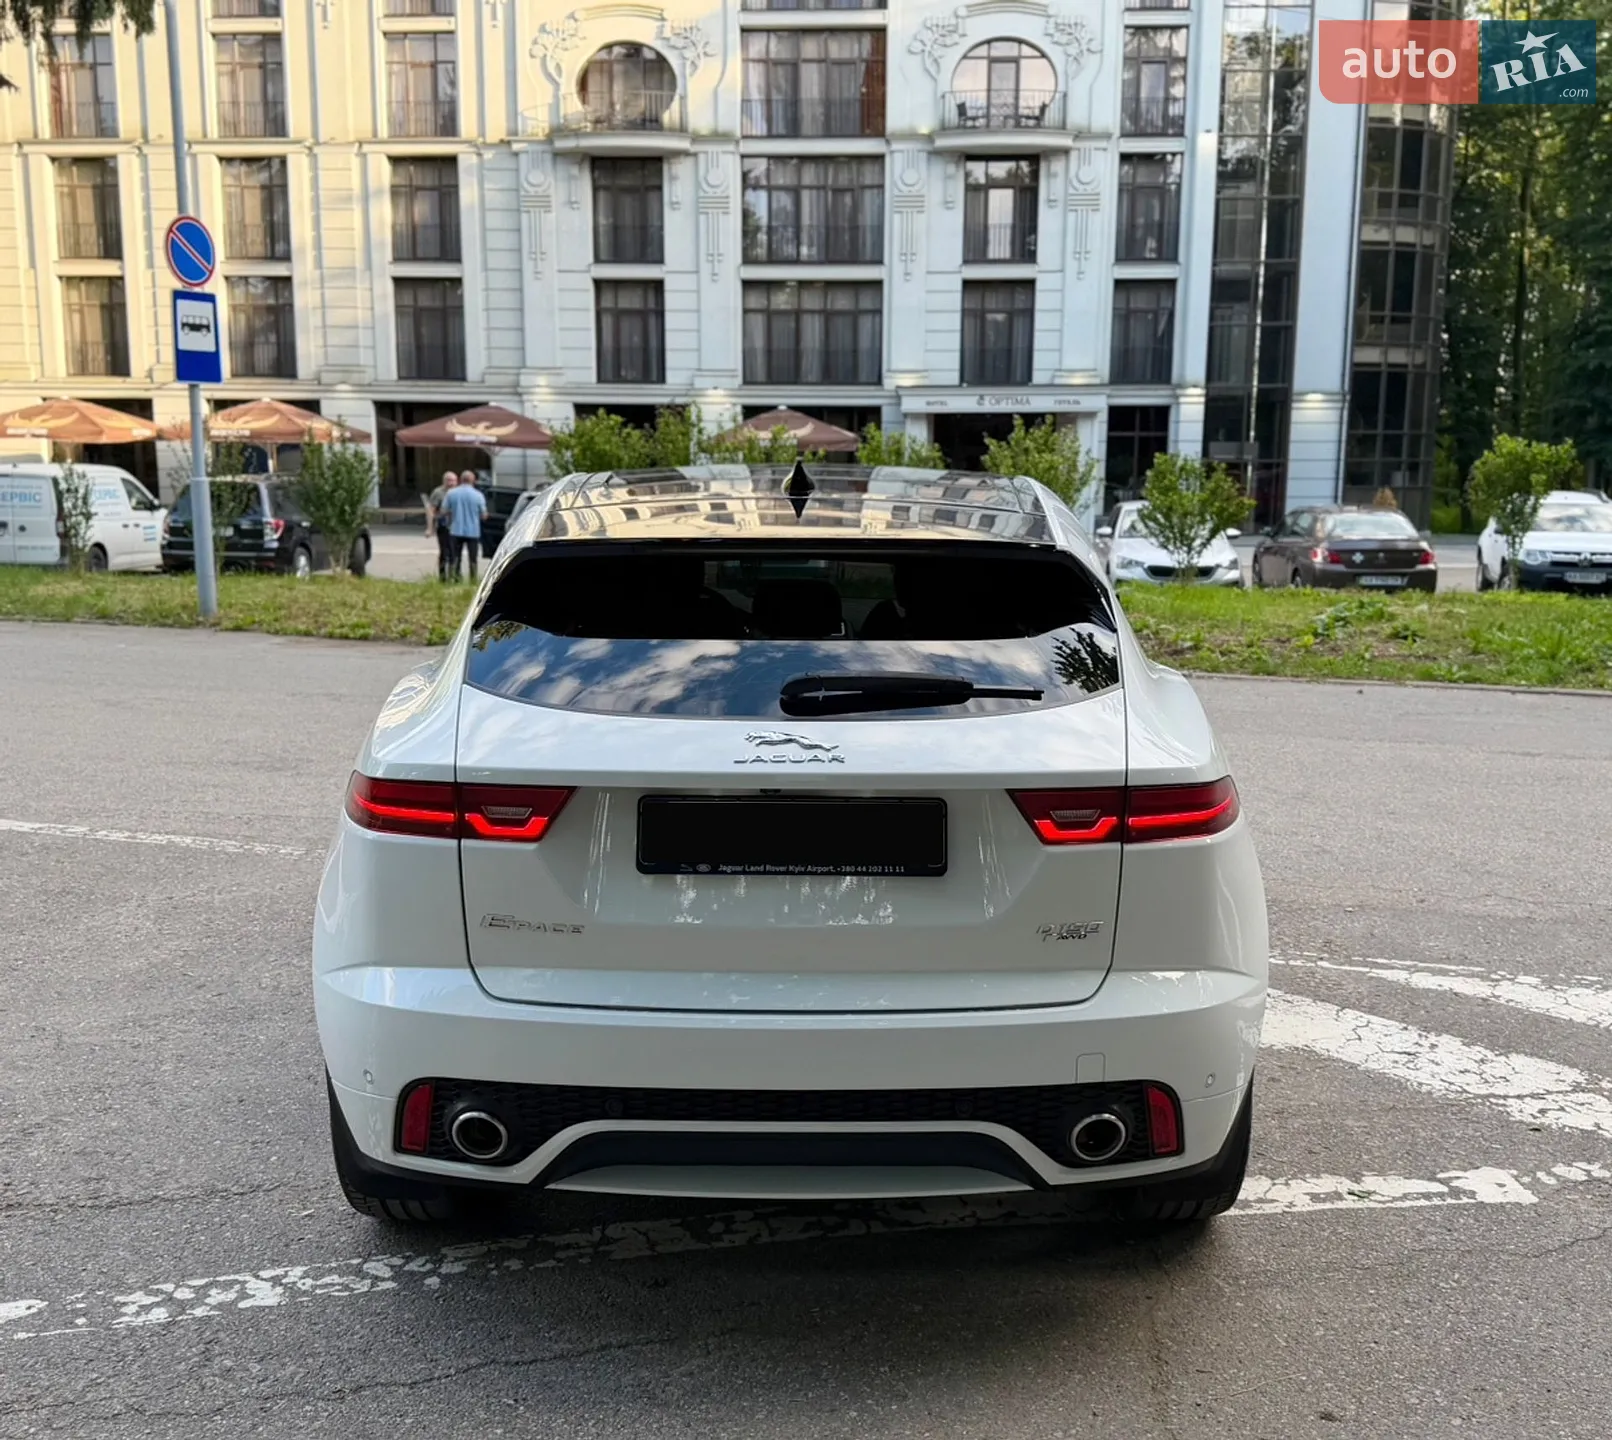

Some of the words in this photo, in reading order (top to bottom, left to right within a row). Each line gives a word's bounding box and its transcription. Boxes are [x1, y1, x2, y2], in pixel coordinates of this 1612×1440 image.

[989, 396, 1031, 407] OPTIMA
[0, 491, 42, 504] ЕРВІС
[733, 753, 845, 764] JAGUAR
[717, 863, 744, 873] Jaguar
[745, 863, 765, 872] Land
[766, 864, 787, 872] Rover
[788, 864, 806, 874] Kyiv
[856, 865, 867, 873] 44
[868, 865, 882, 873] 202
[884, 865, 893, 873] 11
[895, 865, 905, 873] 11
